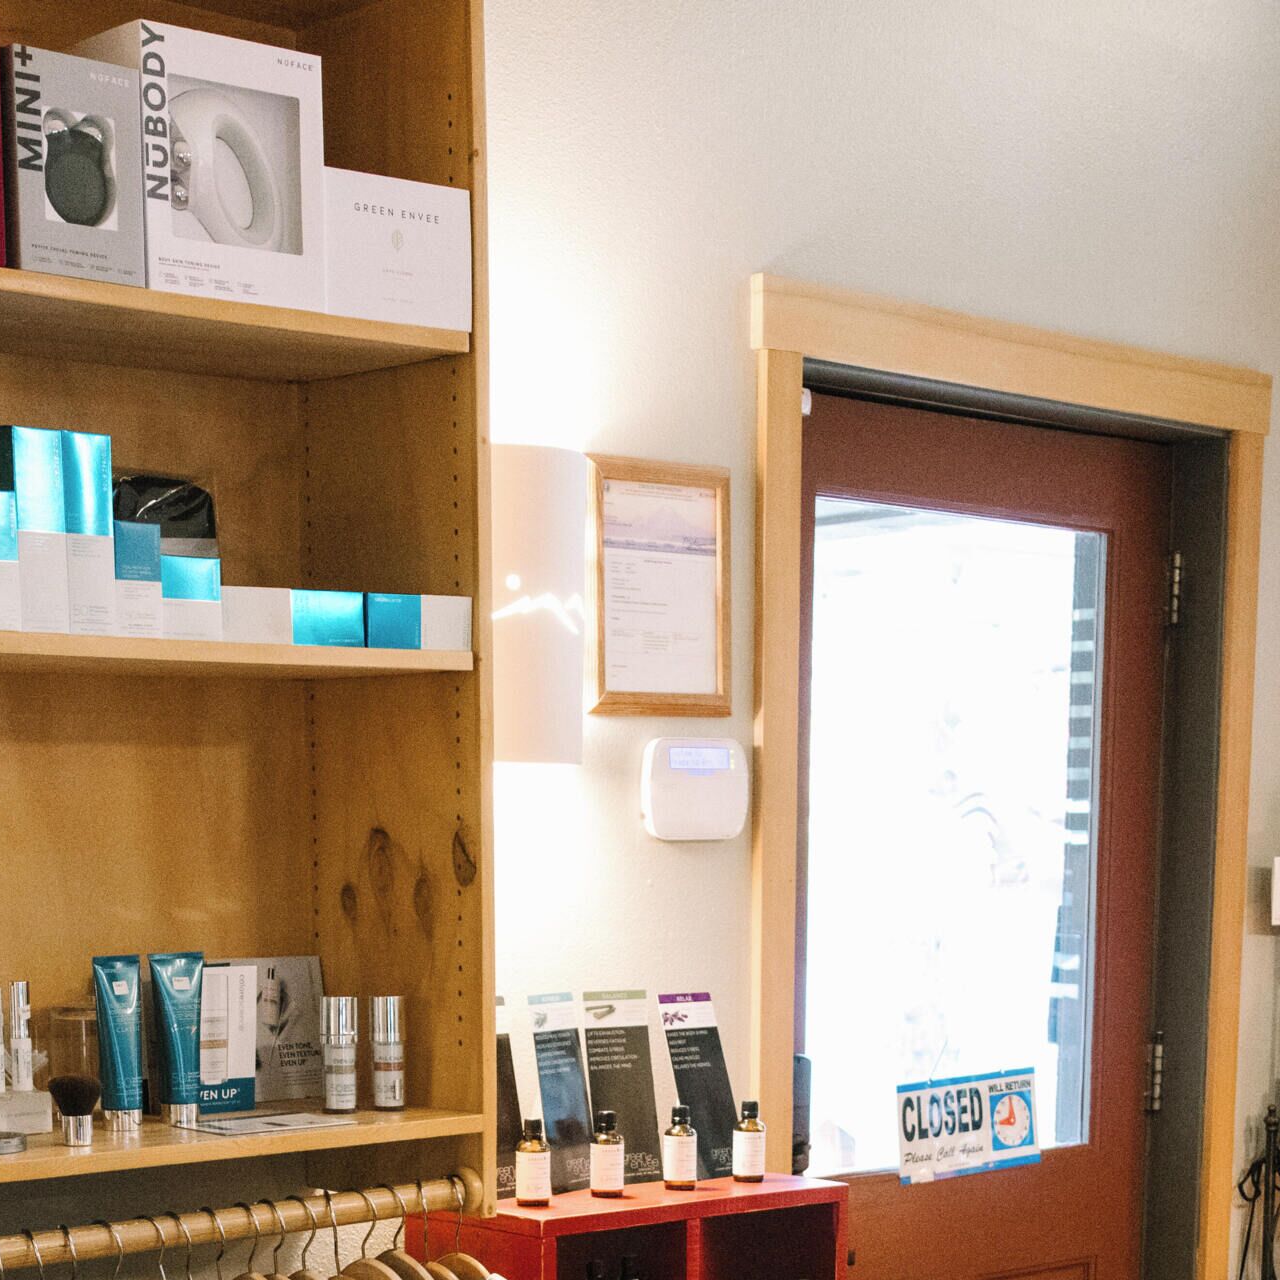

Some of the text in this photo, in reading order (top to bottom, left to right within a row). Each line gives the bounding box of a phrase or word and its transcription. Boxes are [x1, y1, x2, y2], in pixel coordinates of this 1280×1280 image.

[141, 22, 169, 201] NŪBODY
[353, 202, 440, 224] GREEN ENVEE
[278, 1043, 296, 1051] EVEN
[279, 1051, 297, 1059] EVEN
[280, 1059, 296, 1067] EVEN
[988, 1079, 1031, 1094] WILL RETURN
[902, 1087, 983, 1142] CLOSED
[904, 1144, 984, 1165] Please Call Again
